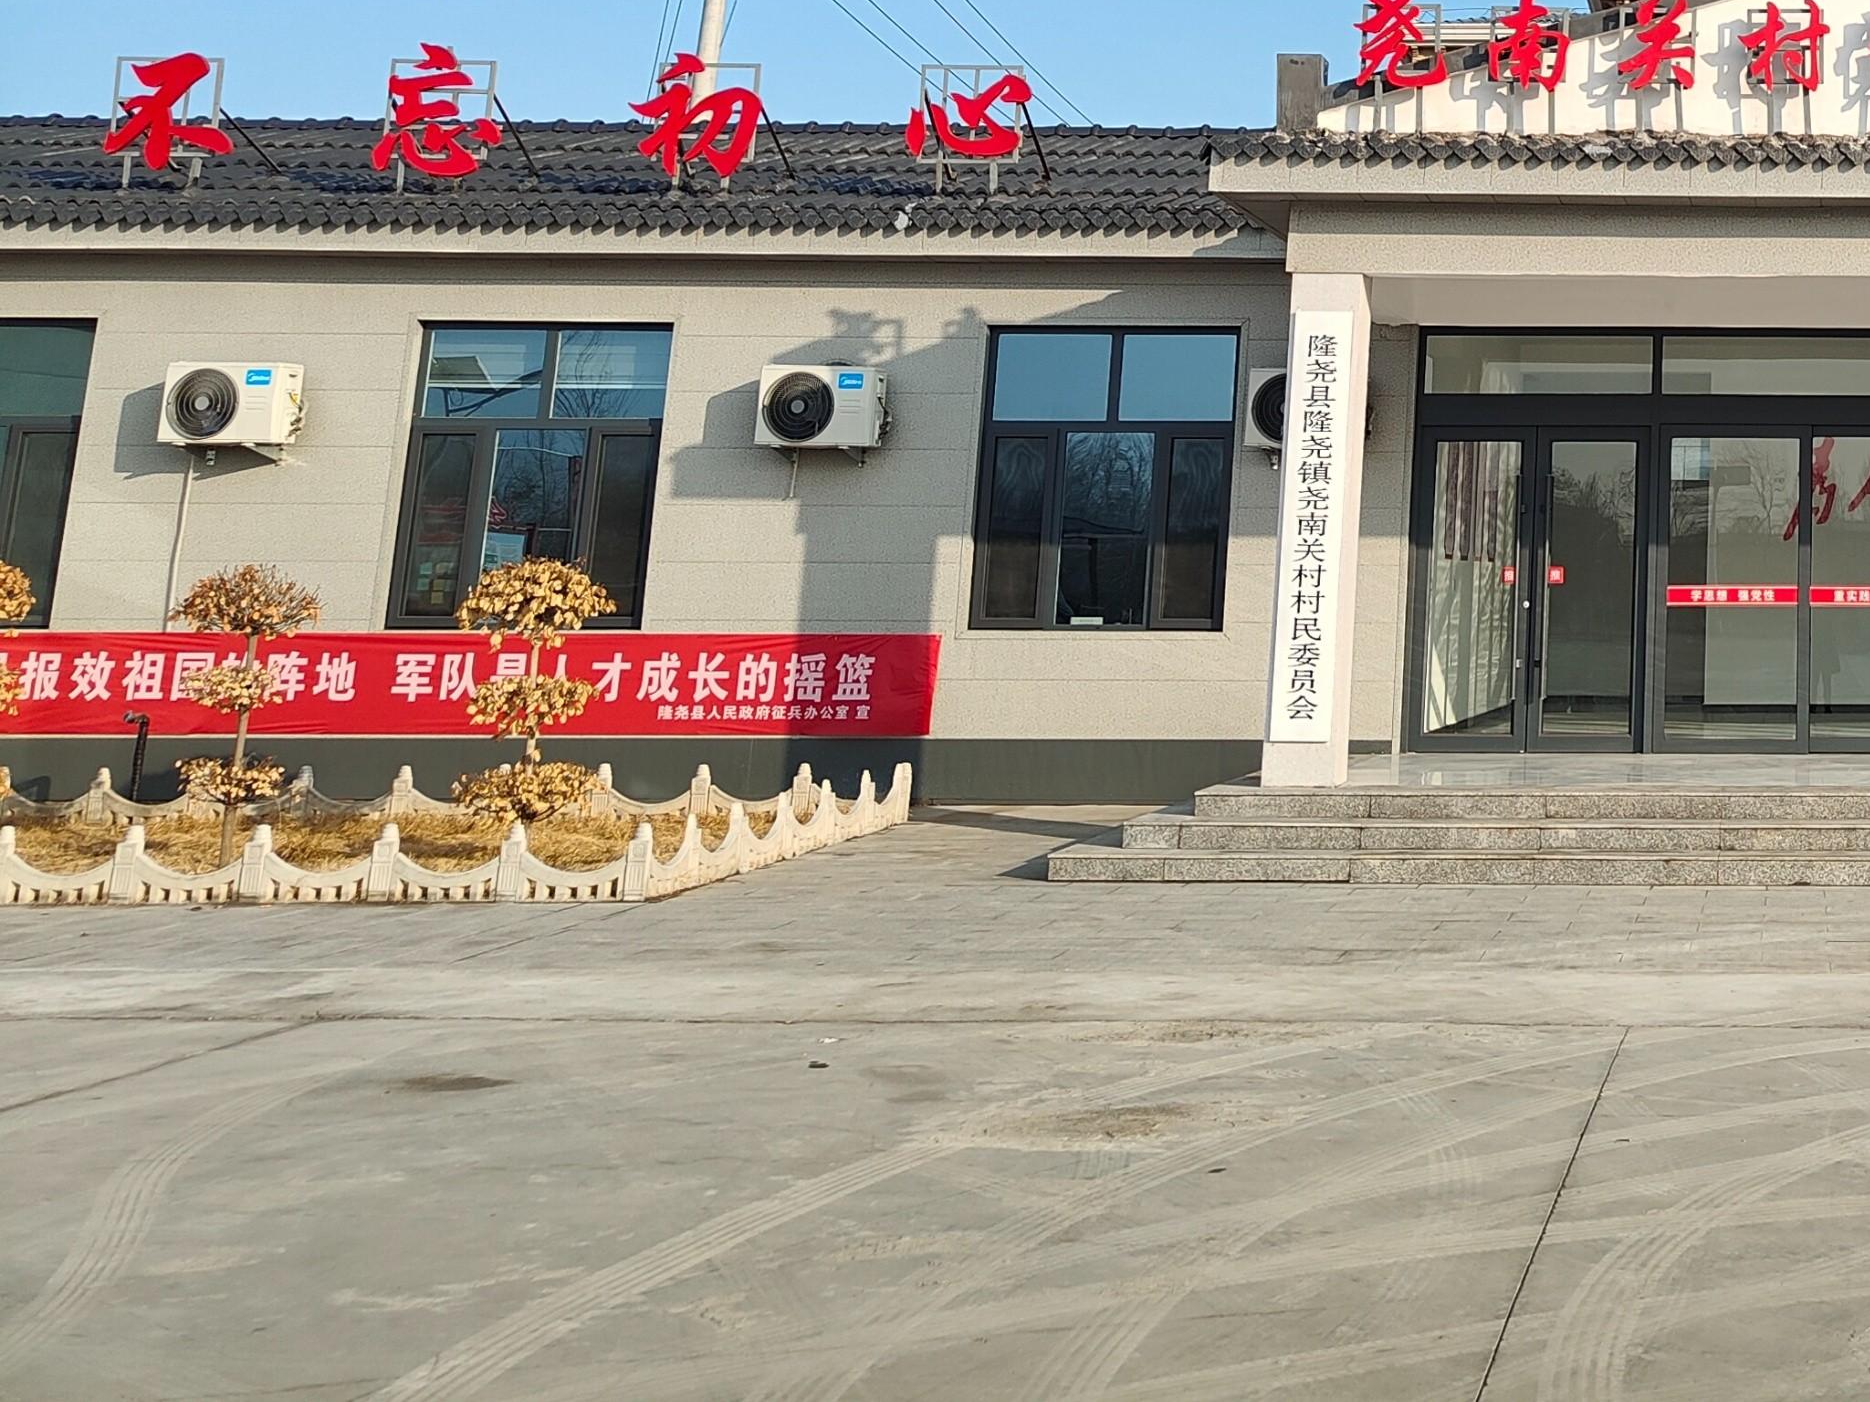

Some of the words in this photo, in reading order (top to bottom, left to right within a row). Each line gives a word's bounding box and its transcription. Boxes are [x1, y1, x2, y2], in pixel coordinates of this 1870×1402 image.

[104, 42, 1032, 177] 不忘初心
[1286, 334, 1338, 721] 隆尧县隆尧镇尧南关村村民委员会
[1690, 589, 1728, 602] 学思想
[0, 651, 357, 702] 报效祖国阵地
[657, 704, 849, 721] 隆尧县人民政府征兵办公室
[855, 705, 870, 720] 宣
